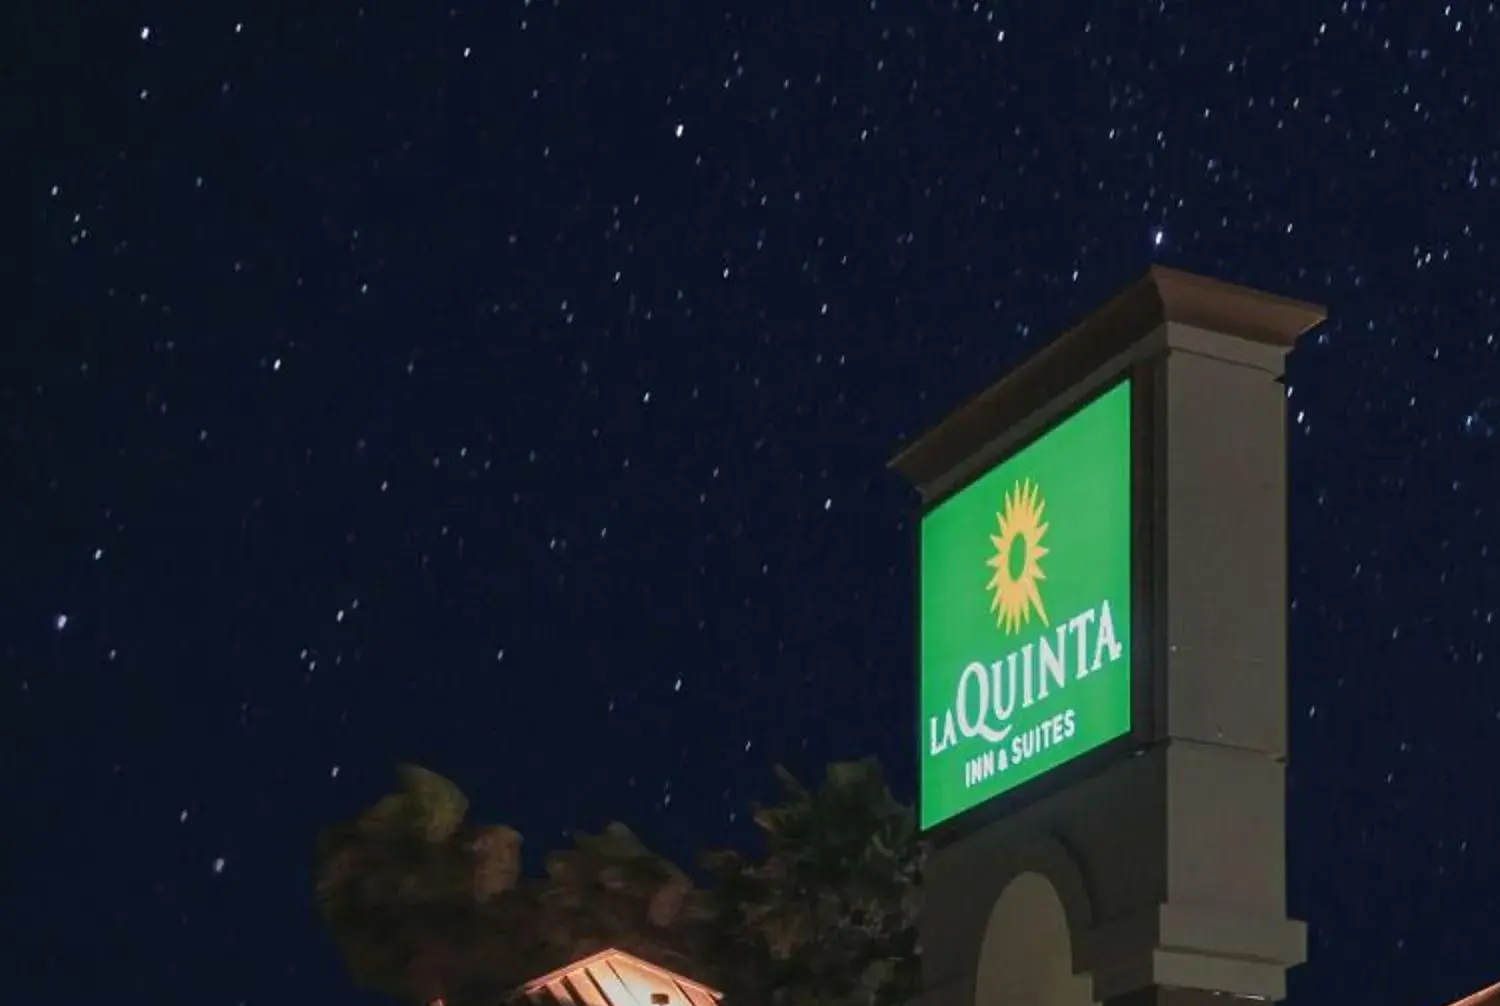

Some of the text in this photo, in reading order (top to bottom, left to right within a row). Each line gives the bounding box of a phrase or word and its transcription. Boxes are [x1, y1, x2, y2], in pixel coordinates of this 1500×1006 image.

[930, 599, 1122, 756] LA QUINTA
[965, 709, 1076, 788] INN & SUITES
